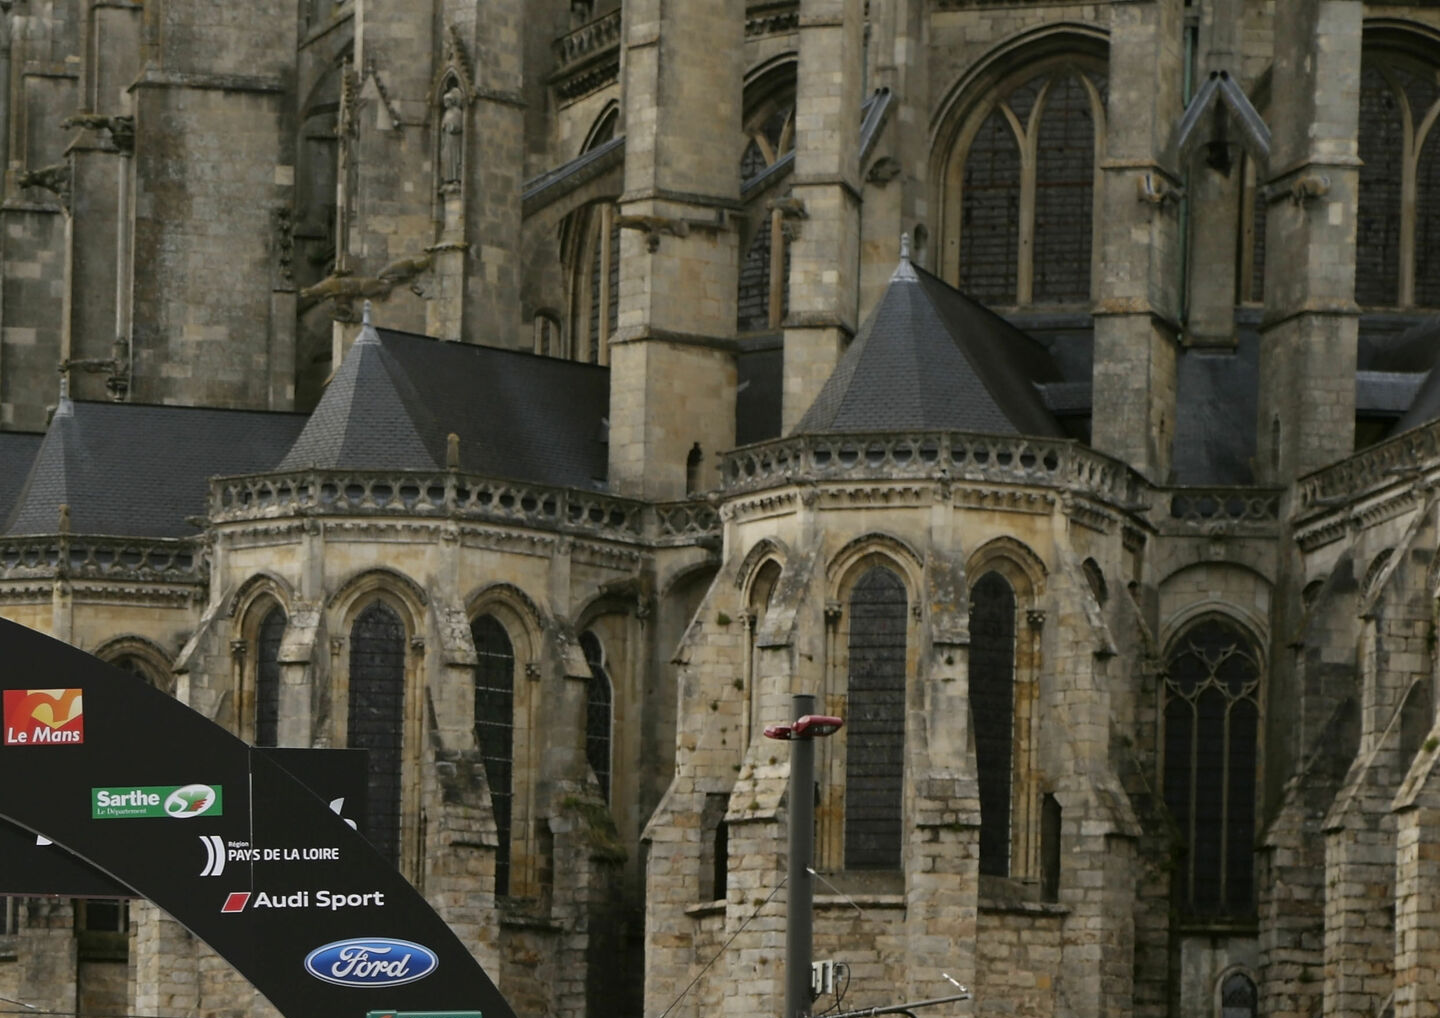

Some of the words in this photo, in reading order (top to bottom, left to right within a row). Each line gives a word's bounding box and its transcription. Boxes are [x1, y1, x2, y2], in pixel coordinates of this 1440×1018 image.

[7, 727, 28, 743] Le
[32, 726, 81, 743] Mans
[97, 790, 161, 807] Sarthe
[107, 807, 147, 816] Département
[228, 840, 250, 848] Région
[228, 848, 261, 861] PAYS
[264, 848, 281, 861] DE
[283, 848, 300, 860] LA
[303, 847, 340, 860] LOIRE
[253, 890, 309, 908] Audi
[315, 889, 385, 911] Sport
[331, 945, 412, 978] Ford
